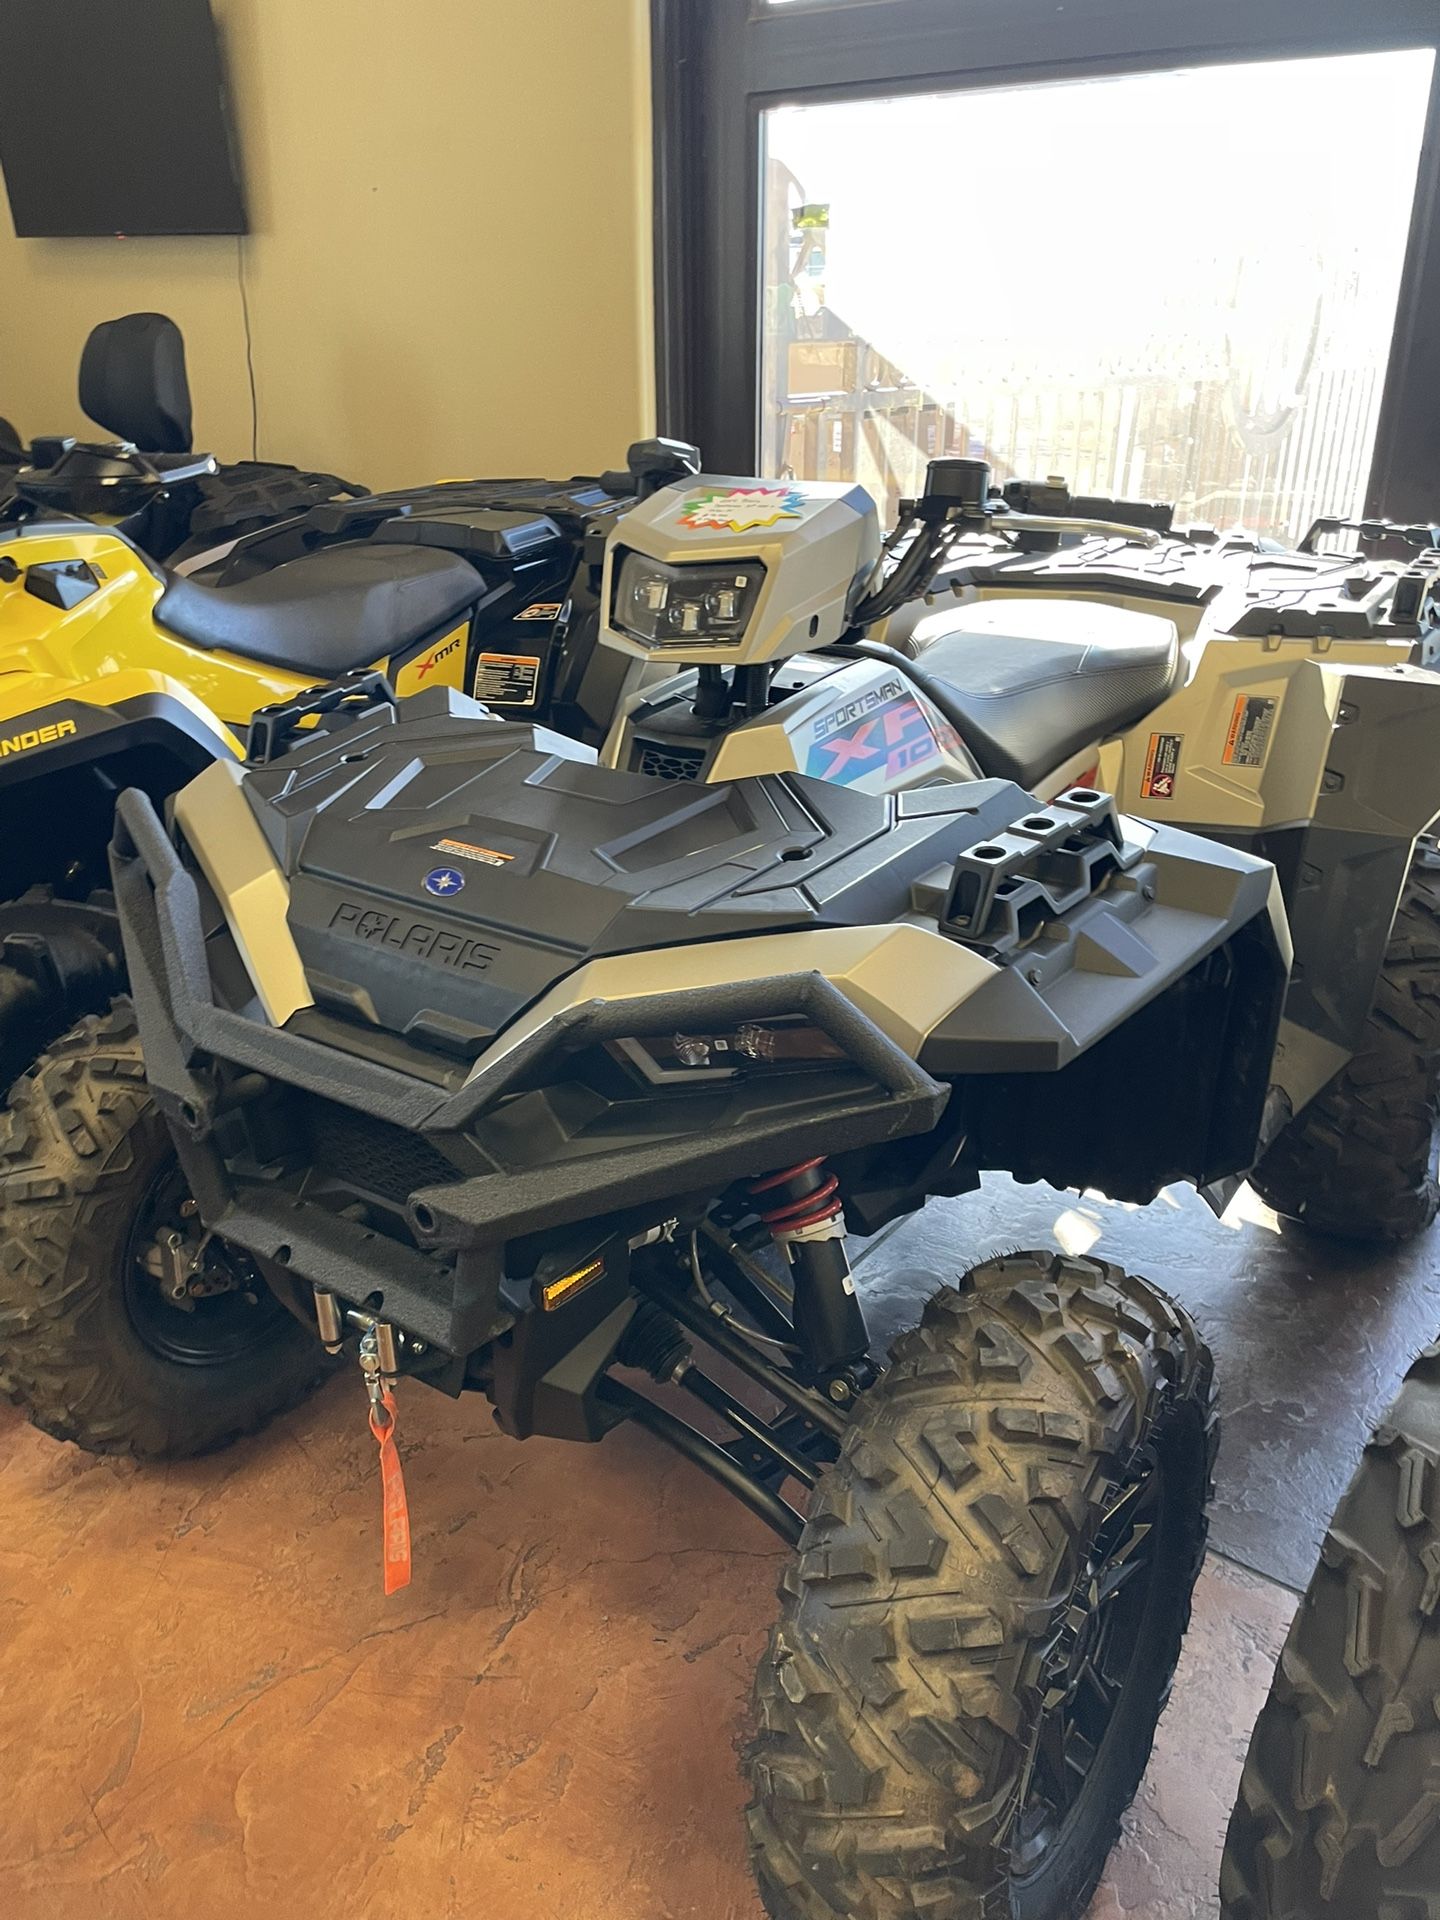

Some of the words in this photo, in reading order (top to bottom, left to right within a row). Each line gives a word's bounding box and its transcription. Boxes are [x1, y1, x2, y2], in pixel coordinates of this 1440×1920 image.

[0, 719, 77, 757] NDER
[813, 678, 903, 739] SPORTSMAN
[328, 902, 501, 969] POLARIS
